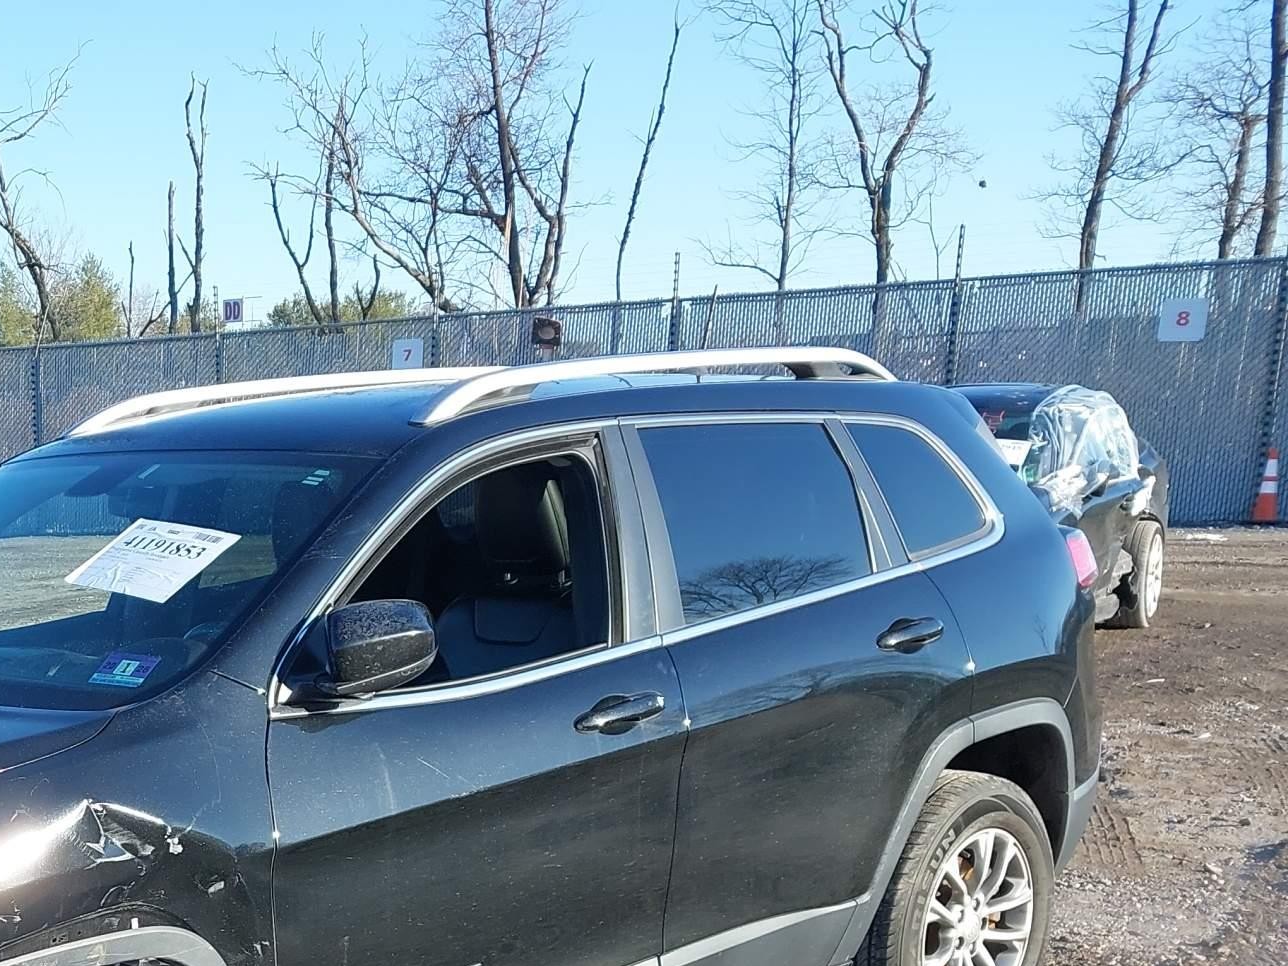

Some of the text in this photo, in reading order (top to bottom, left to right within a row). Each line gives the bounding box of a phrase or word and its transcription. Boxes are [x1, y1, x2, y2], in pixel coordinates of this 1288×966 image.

[225, 301, 241, 321] DD
[1175, 310, 1191, 327] 8
[403, 349, 412, 361] 7
[123, 534, 208, 560] 41191853
